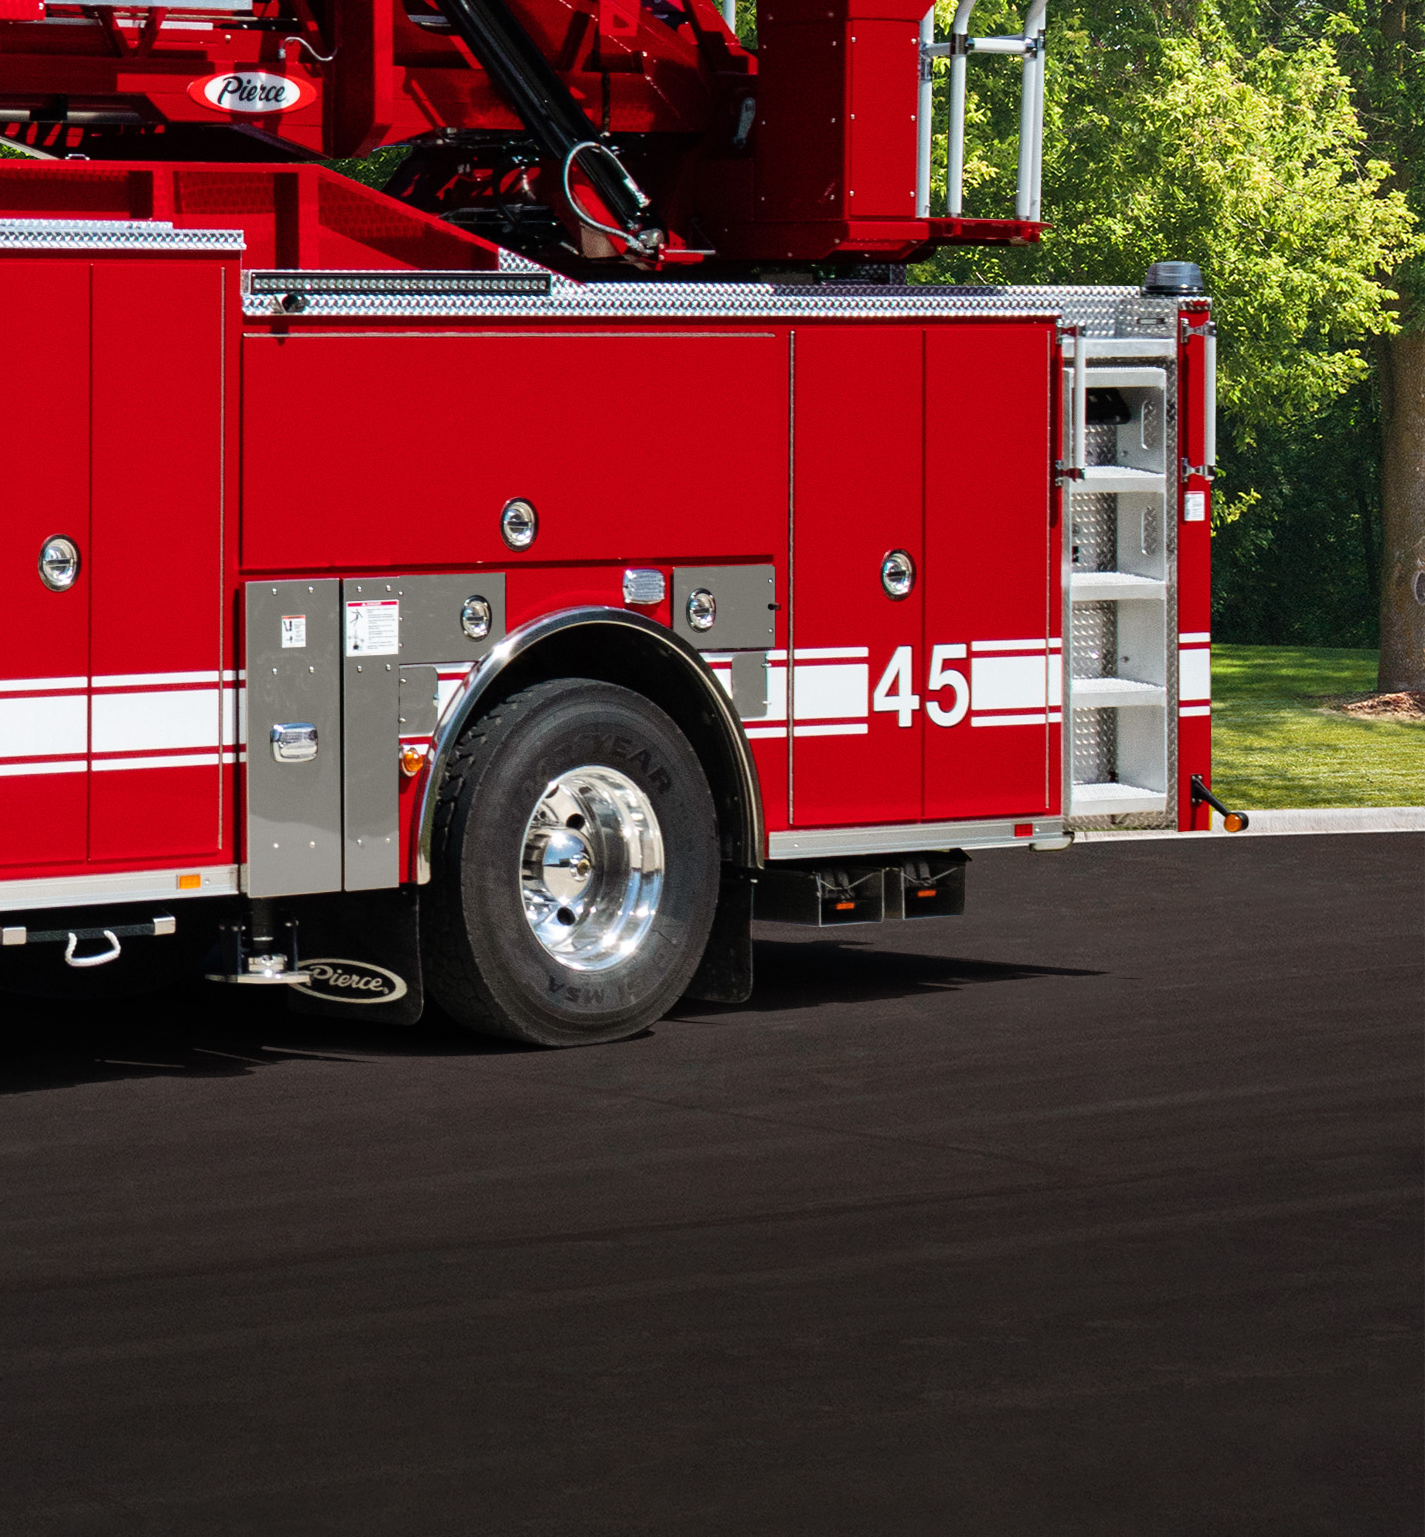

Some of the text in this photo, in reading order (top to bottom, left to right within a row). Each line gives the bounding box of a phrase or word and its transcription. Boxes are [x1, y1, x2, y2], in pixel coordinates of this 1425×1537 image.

[217, 75, 287, 105] Pierce
[873, 644, 970, 727] 45
[304, 965, 385, 990] Pierce
